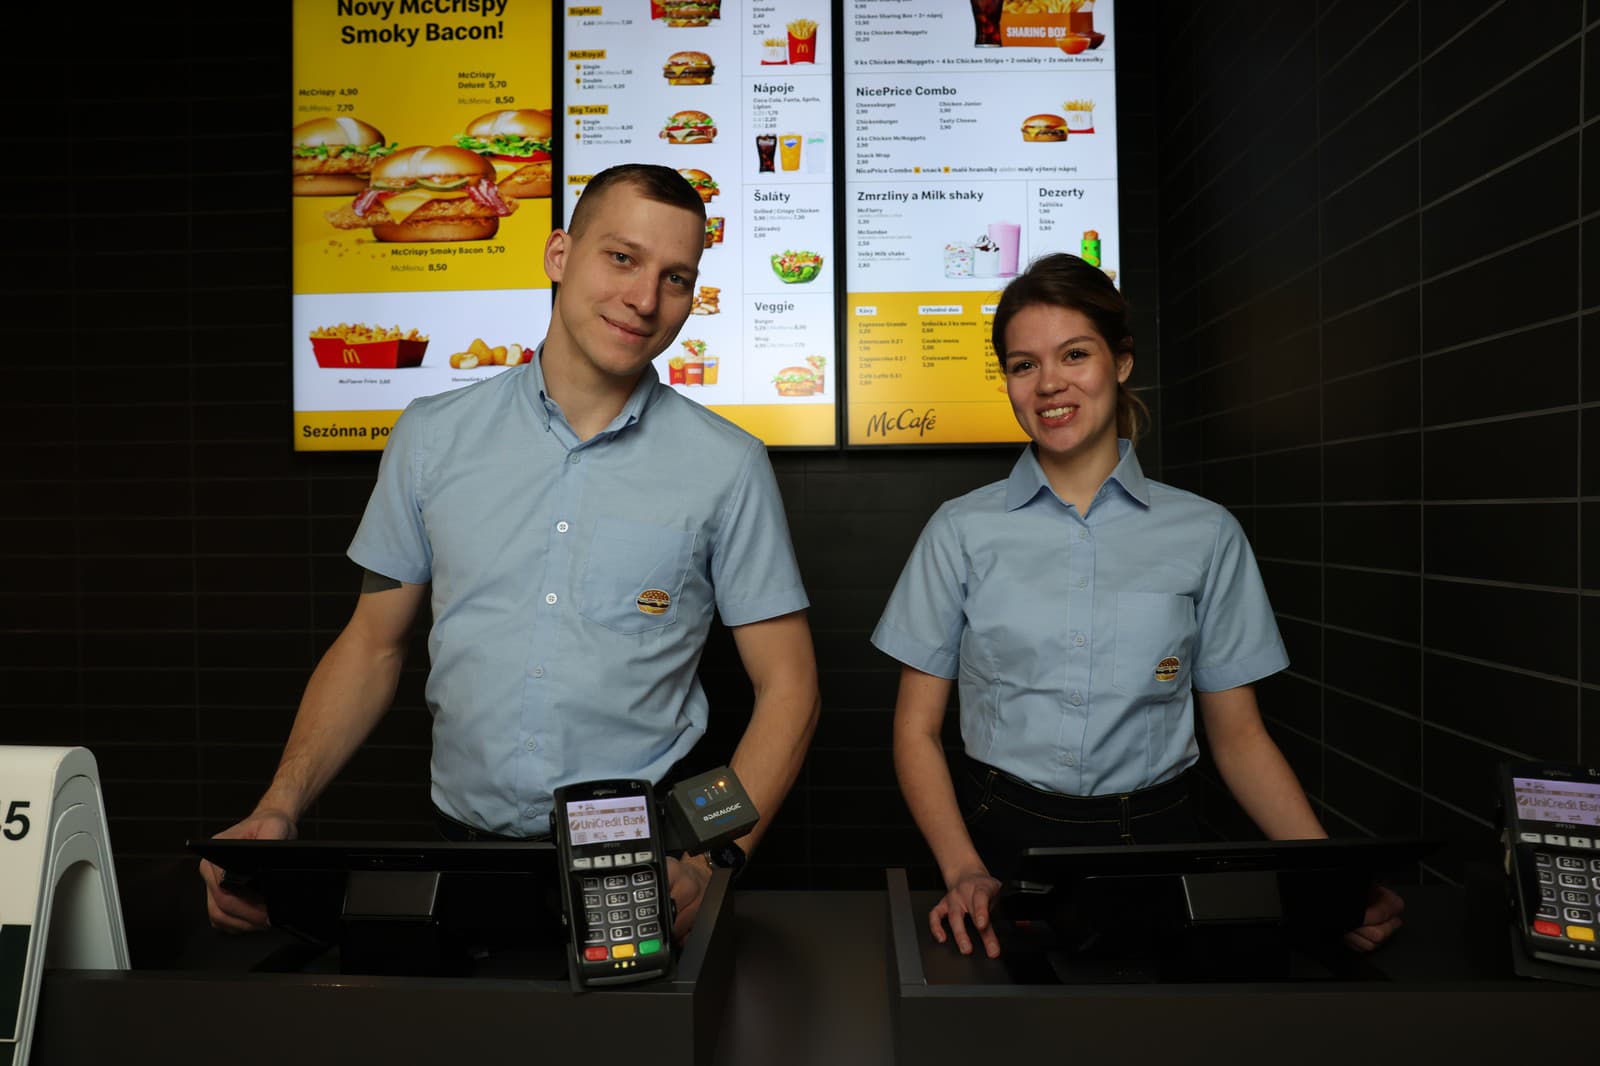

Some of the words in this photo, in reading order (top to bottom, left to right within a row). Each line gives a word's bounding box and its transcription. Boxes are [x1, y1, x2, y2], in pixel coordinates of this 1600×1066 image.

[399, 0, 508, 17] McCrispy
[341, 24, 420, 47] Smoky
[425, 21, 504, 42] Bacon!
[1006, 27, 1046, 38] SHARING
[1047, 26, 1066, 38] BOX
[897, 58, 935, 66] McNuggets
[458, 71, 496, 81] McCrispy
[488, 80, 507, 90] 5,70
[753, 83, 795, 95] Nápoje
[299, 88, 337, 98] McCrispy
[856, 86, 913, 97] NicePrice
[915, 86, 957, 96] Combo
[495, 96, 515, 104] 8,50
[336, 103, 354, 112] 7,70
[570, 106, 582, 115] Big
[584, 106, 606, 114] Tasty
[754, 190, 791, 204] Šaláty
[857, 190, 909, 204] Zmrzliny
[921, 190, 946, 200] Milk
[949, 190, 984, 202] shaky
[1039, 188, 1085, 200] Dezerty
[391, 248, 429, 258] McCrispy
[430, 247, 457, 258] Smoky
[459, 246, 484, 255] Bacon
[486, 246, 506, 255] 5,70
[428, 263, 448, 272] 8,50
[754, 300, 795, 314] Veggie
[866, 408, 936, 438] McCafé
[303, 424, 368, 438] Sezónna
[1528, 797, 1578, 810] UniCredit
[708, 803, 742, 820] DATALOGIC
[580, 816, 622, 830] UniCredit
[623, 815, 646, 826] Bank
[1563, 858, 1570, 867] 2
[638, 874, 644, 882] 3
[1565, 876, 1573, 884] 5
[638, 891, 645, 899] 6
[1568, 893, 1576, 901] 8
[612, 912, 619, 920] 8
[639, 908, 646, 916] 9
[1570, 910, 1580, 918] 0
[614, 928, 622, 937] 0
